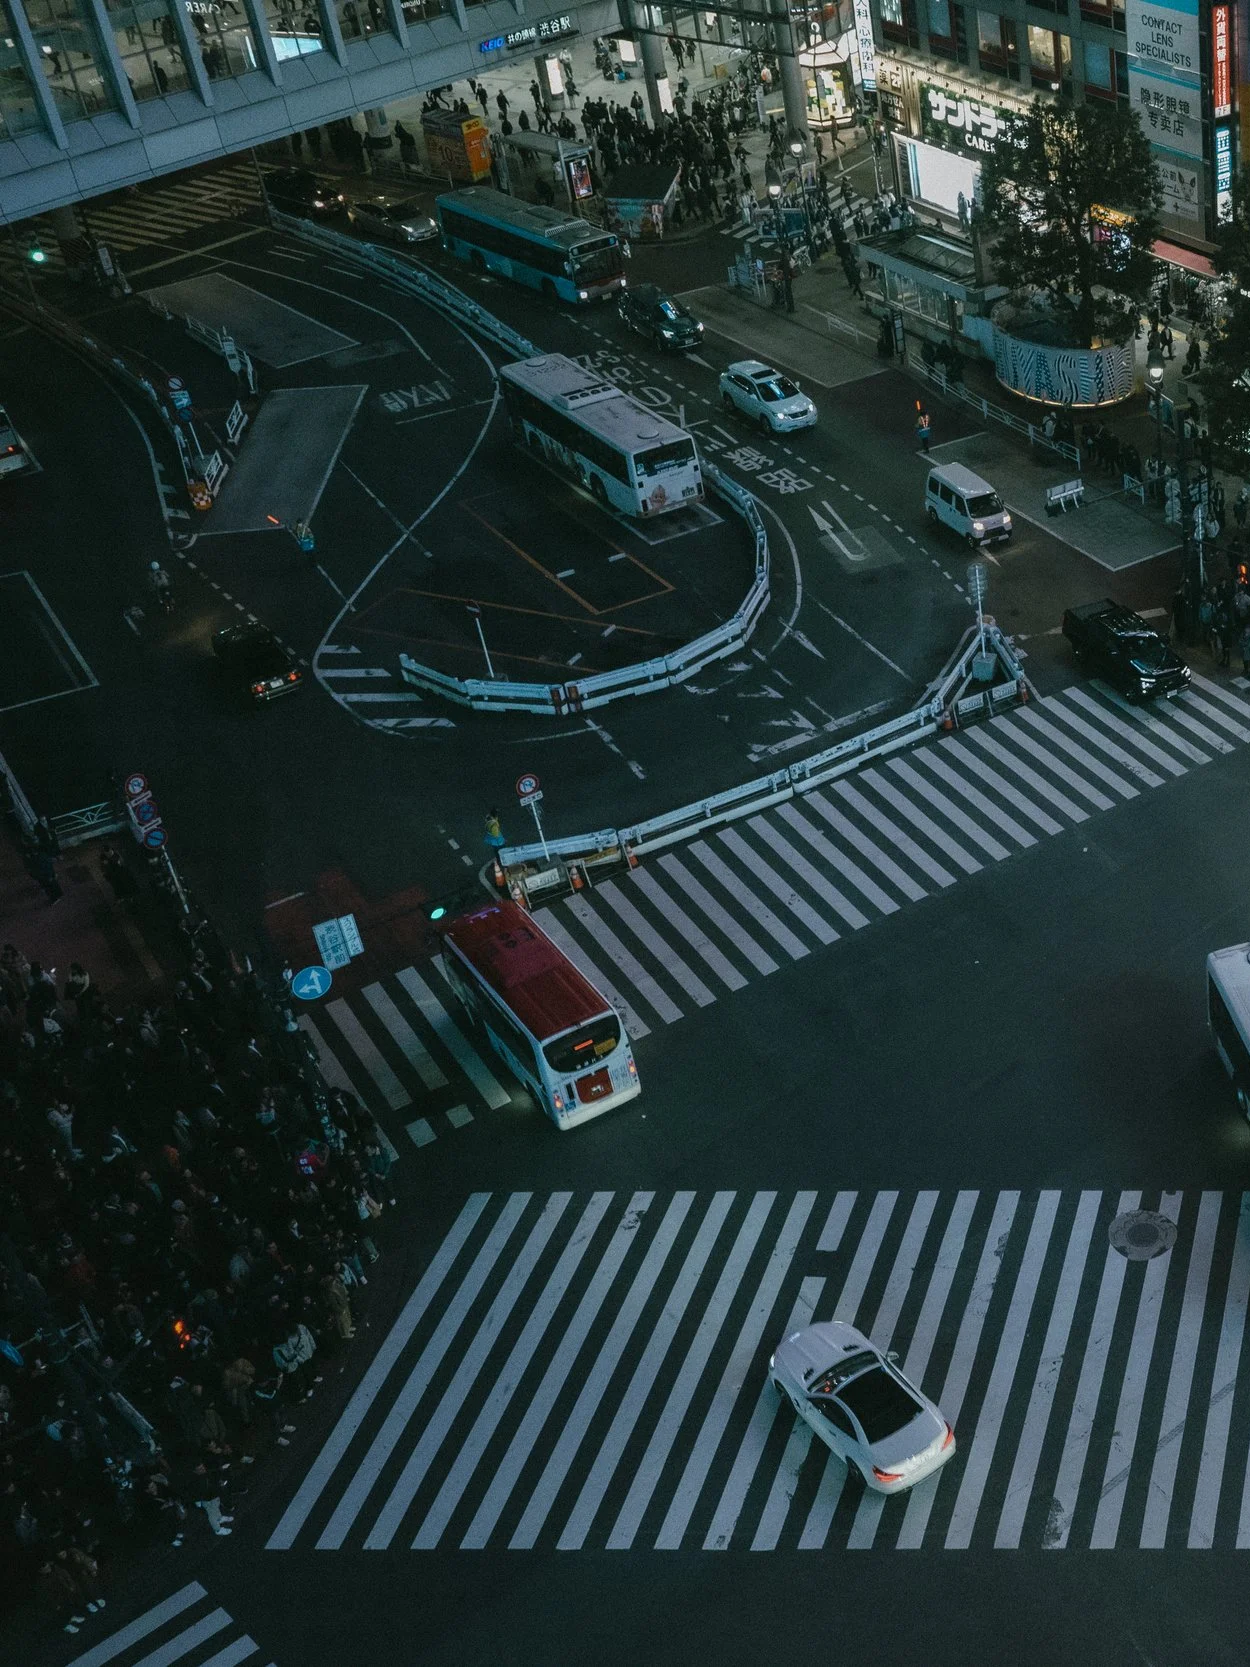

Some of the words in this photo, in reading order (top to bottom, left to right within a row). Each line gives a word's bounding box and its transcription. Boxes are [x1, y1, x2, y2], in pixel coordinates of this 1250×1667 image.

[507, 27, 537, 44] 井の頭線
[539, 16, 571, 36] 渋谷駅
[1141, 14, 1182, 36] CONTACT
[480, 37, 505, 53] KEIO
[1151, 31, 1174, 47] LENS
[1135, 41, 1192, 67] SPECIALISTS
[1148, 111, 1185, 137] 专卖店
